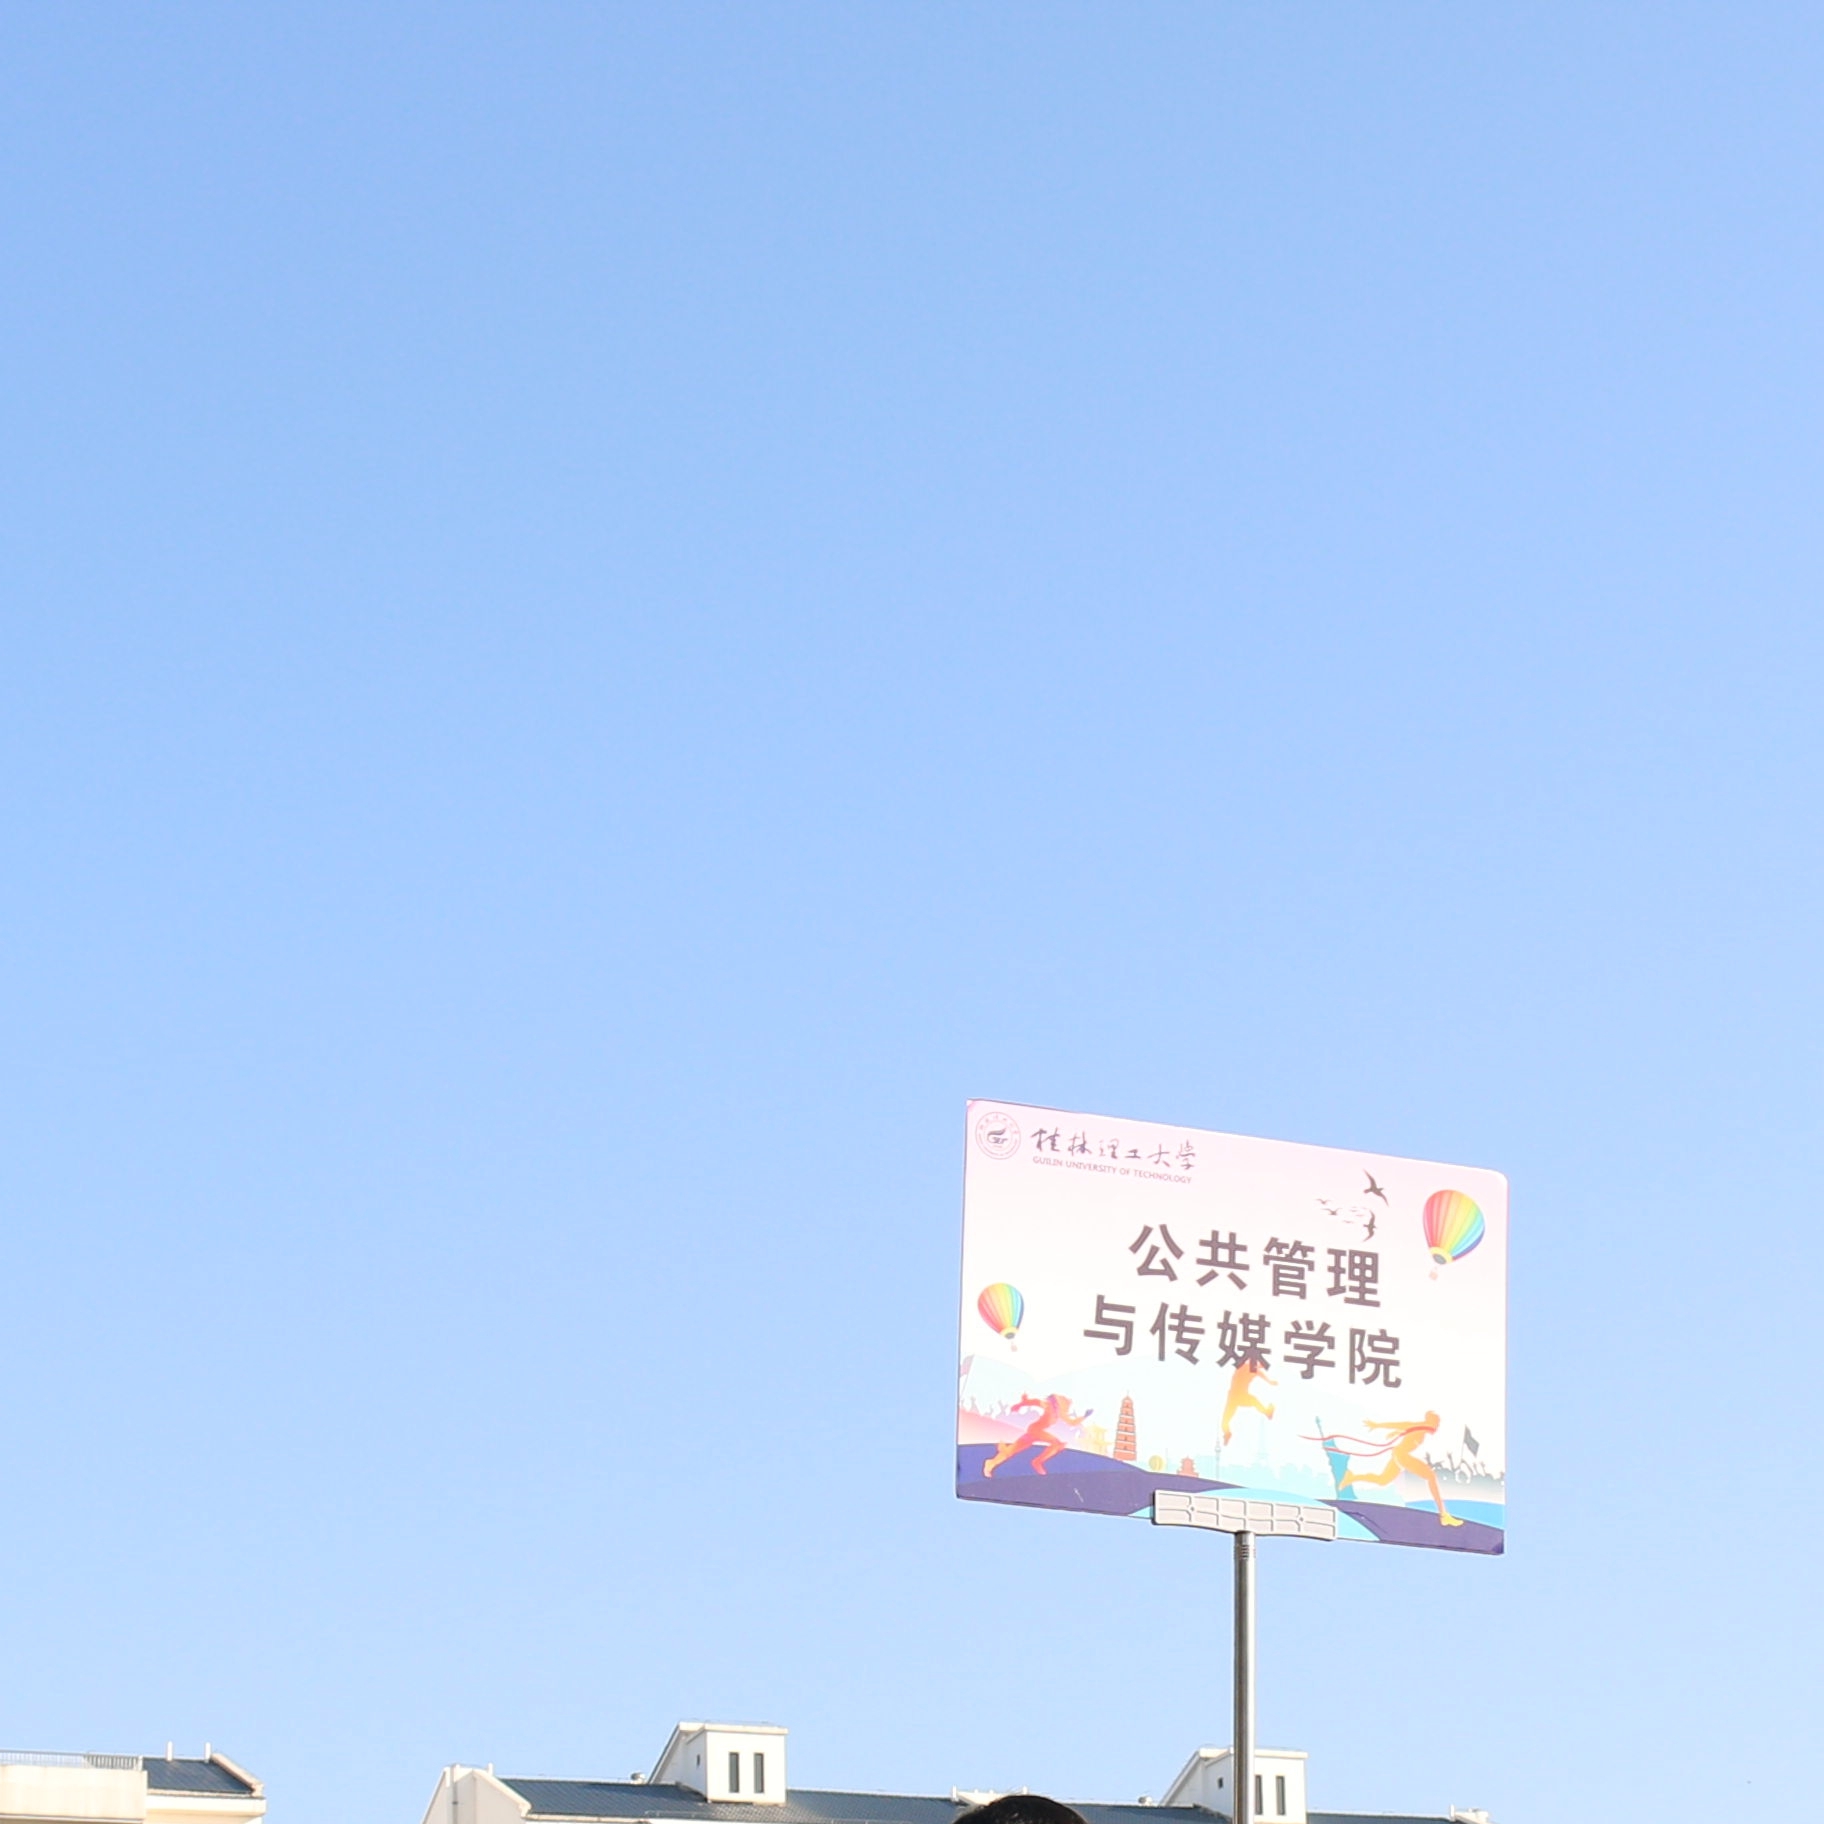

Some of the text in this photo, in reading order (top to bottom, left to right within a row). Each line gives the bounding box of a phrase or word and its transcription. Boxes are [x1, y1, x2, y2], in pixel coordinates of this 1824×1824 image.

[1031, 1128, 1196, 1170] 桂林理工大学
[1033, 1155, 1192, 1184] GUILIN UNIVERSITY OF TECHNOLOGY
[1129, 1224, 1380, 1308] 公共管理
[1084, 1294, 1402, 1388] 与传媒学院
